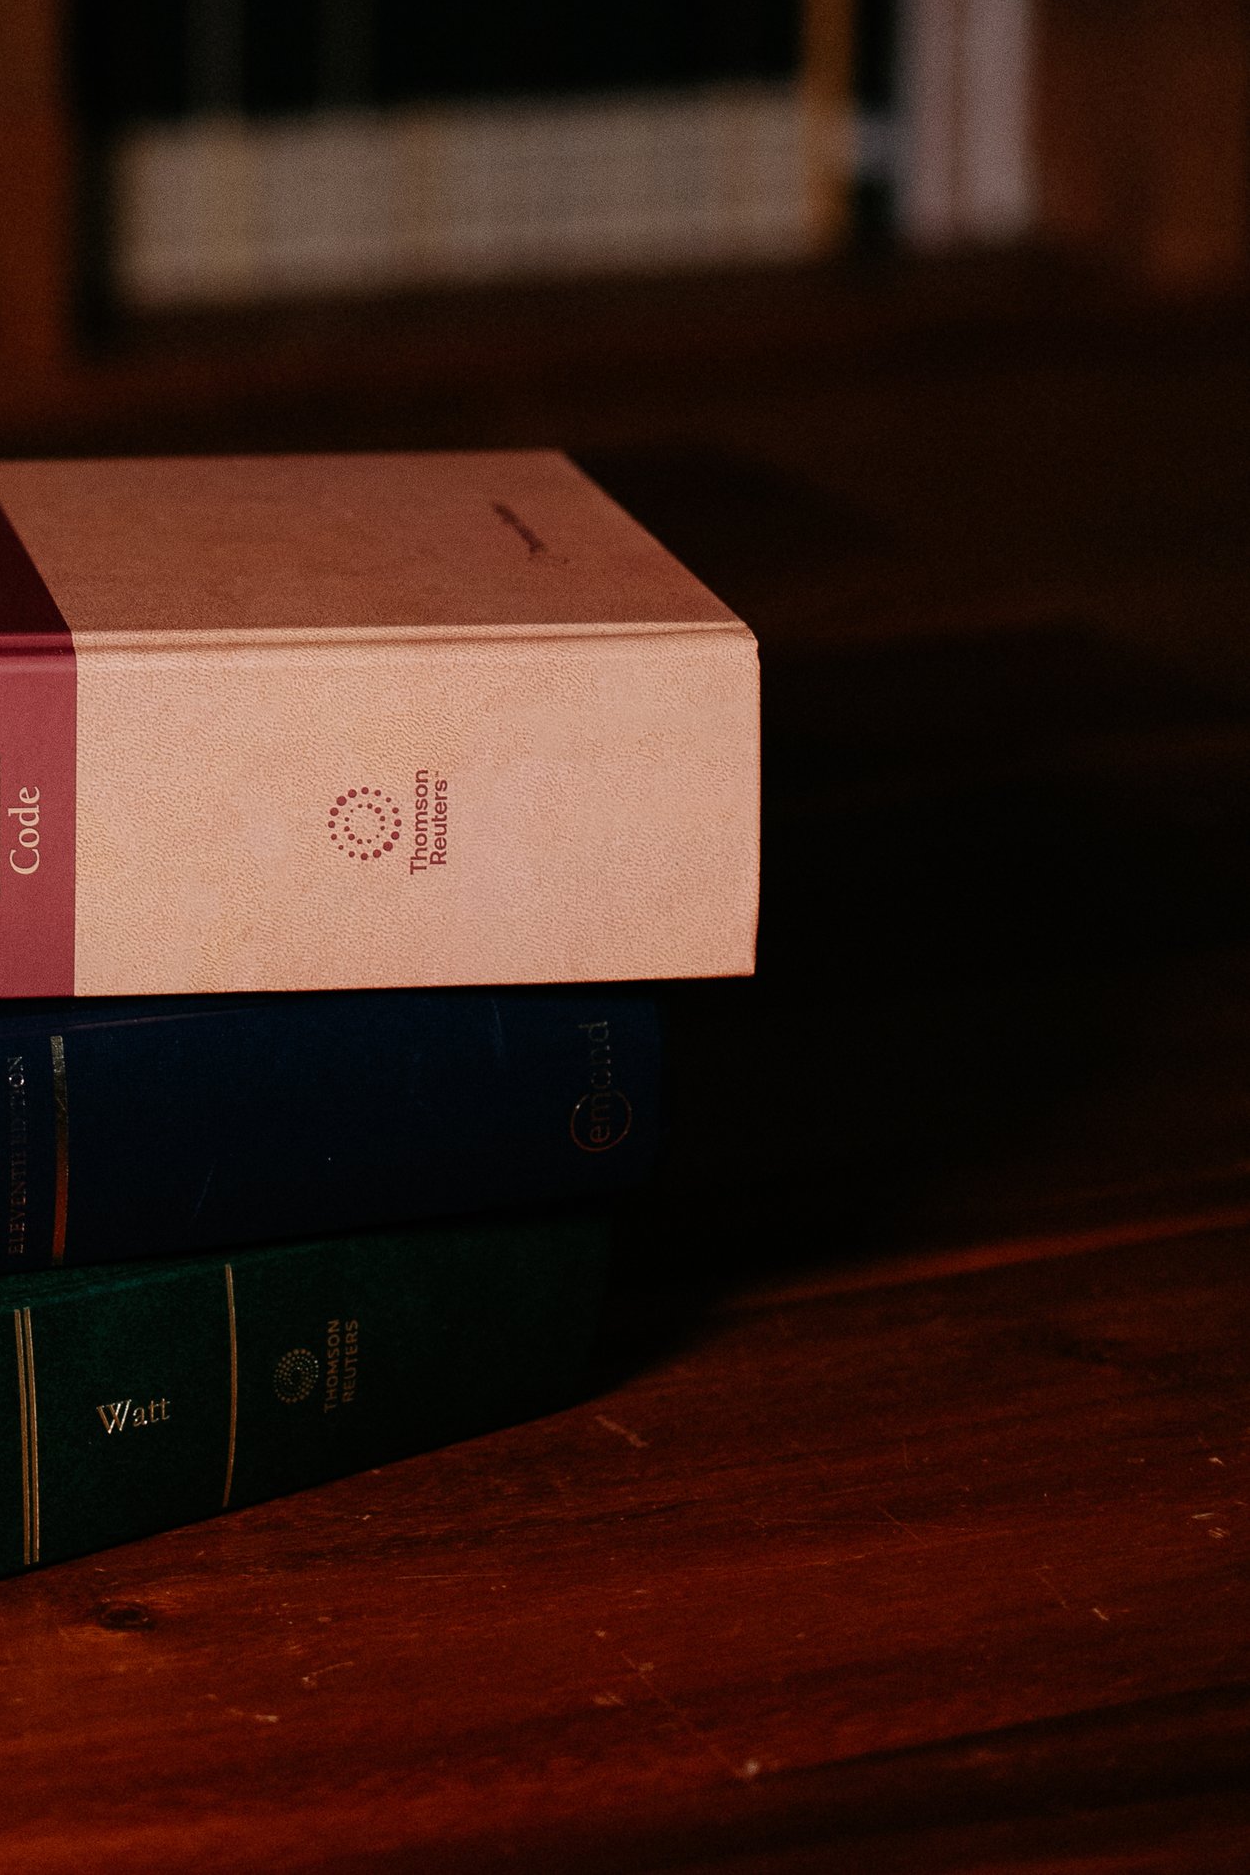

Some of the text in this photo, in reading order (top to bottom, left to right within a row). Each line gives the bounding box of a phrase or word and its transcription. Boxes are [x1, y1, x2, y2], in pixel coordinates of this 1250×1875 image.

[8, 785, 40, 875] Code
[410, 769, 429, 876] Thomson
[430, 778, 448, 865] Reuters
[323, 1317, 342, 1414] THOMSON
[341, 1317, 360, 1405] REUTERS
[95, 1397, 171, 1435] Watt
